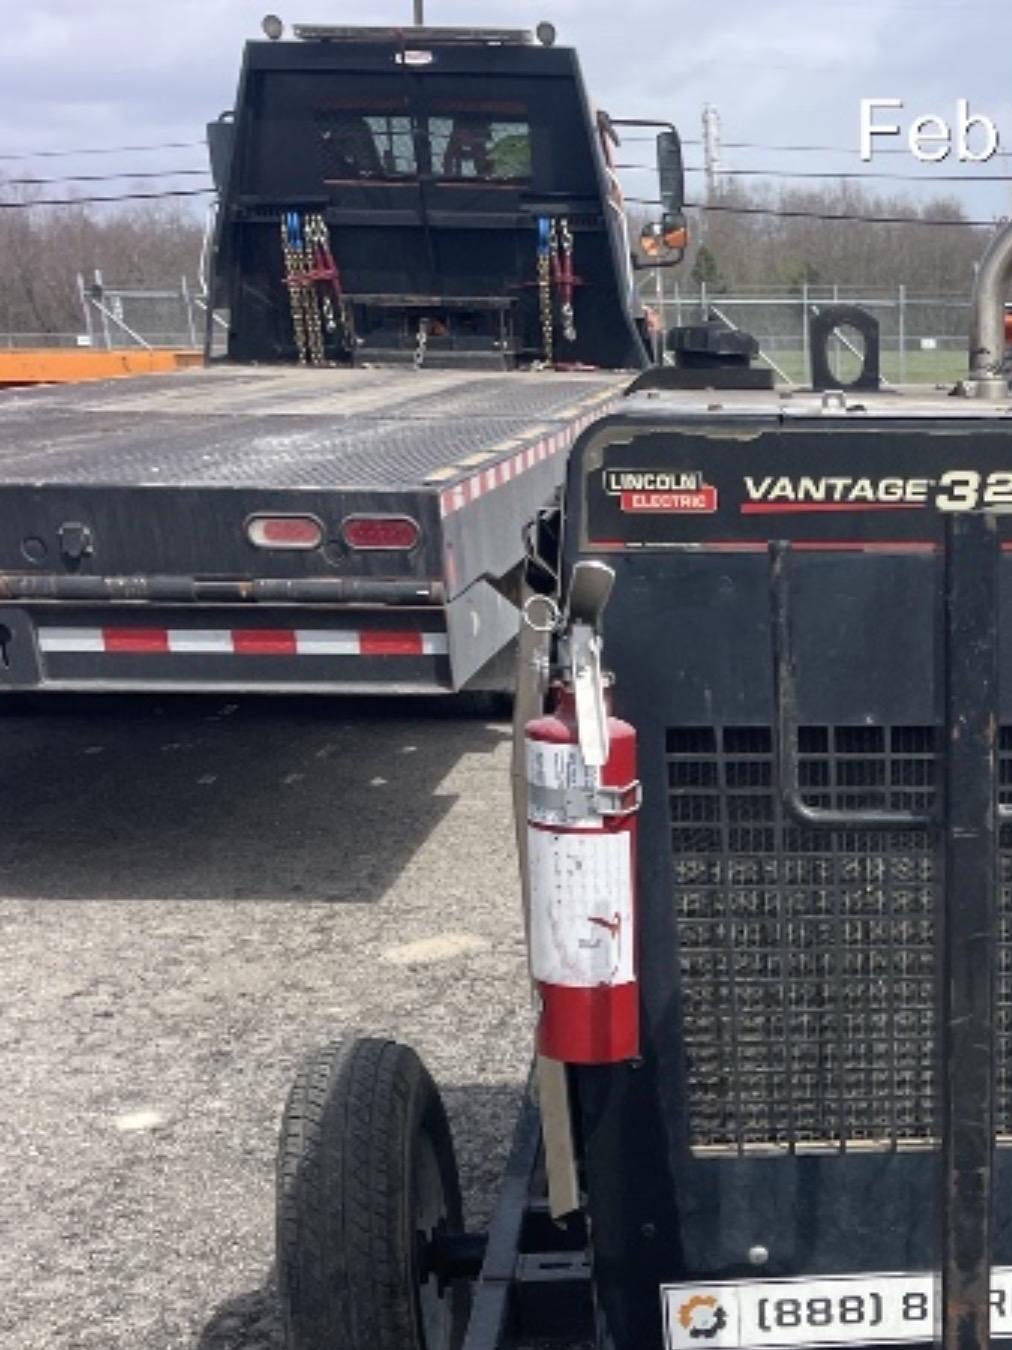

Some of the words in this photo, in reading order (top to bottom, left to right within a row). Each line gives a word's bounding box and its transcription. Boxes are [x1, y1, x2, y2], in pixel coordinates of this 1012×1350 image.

[609, 472, 698, 490] LINCOLN
[743, 476, 931, 502] VANTAGE
[631, 494, 706, 508] ELECTRIC
[757, 1292, 883, 1332] (888)
